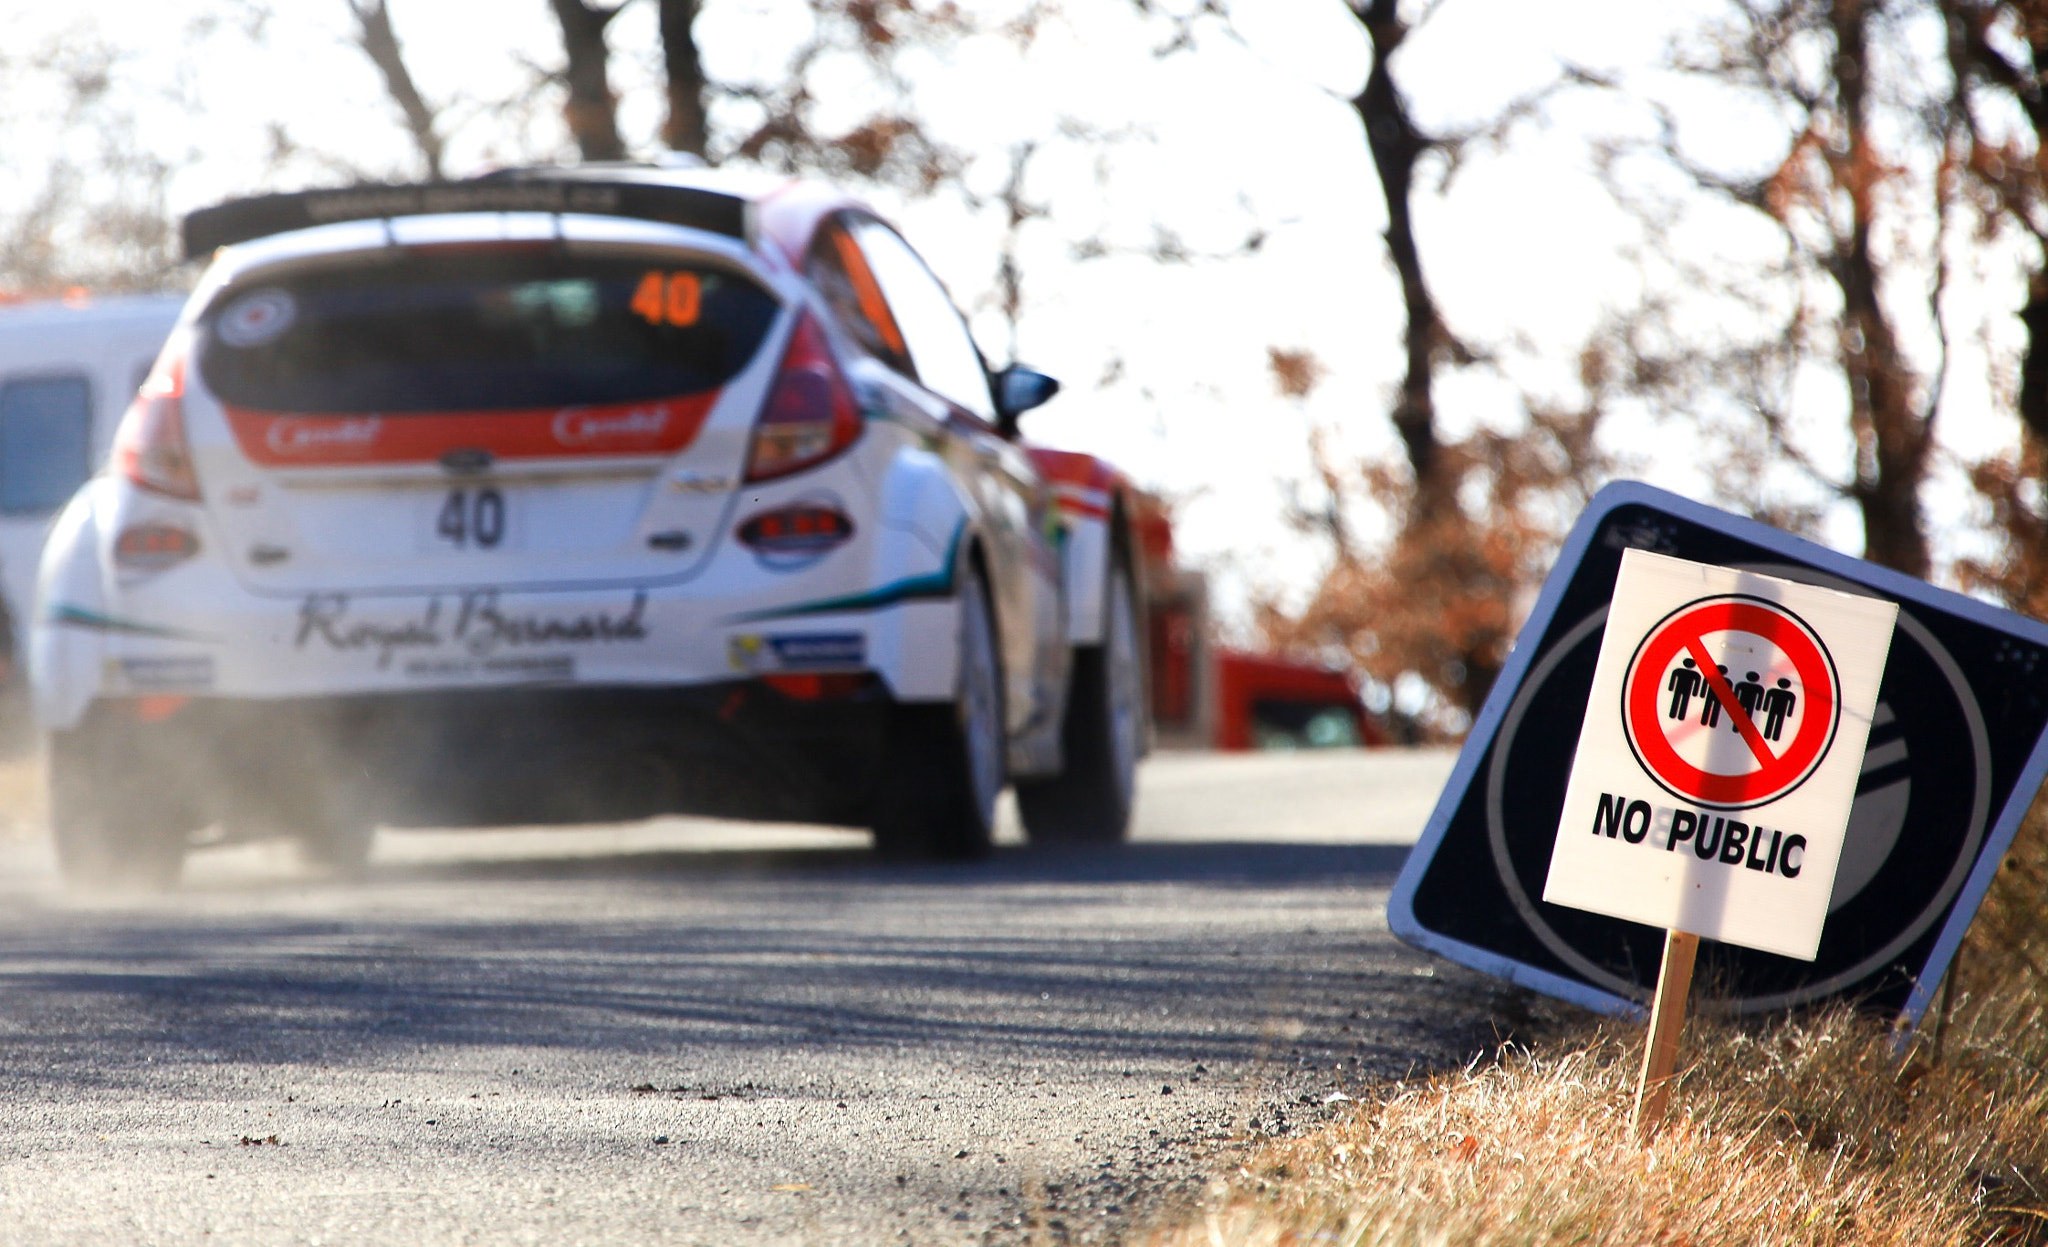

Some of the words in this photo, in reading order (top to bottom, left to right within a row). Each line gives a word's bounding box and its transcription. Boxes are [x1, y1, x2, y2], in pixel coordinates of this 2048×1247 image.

[631, 270, 701, 326] 40
[438, 489, 506, 549] 40
[295, 593, 443, 671] Royal
[1592, 792, 1652, 844] NO
[1666, 808, 1807, 878] PUBLIC
